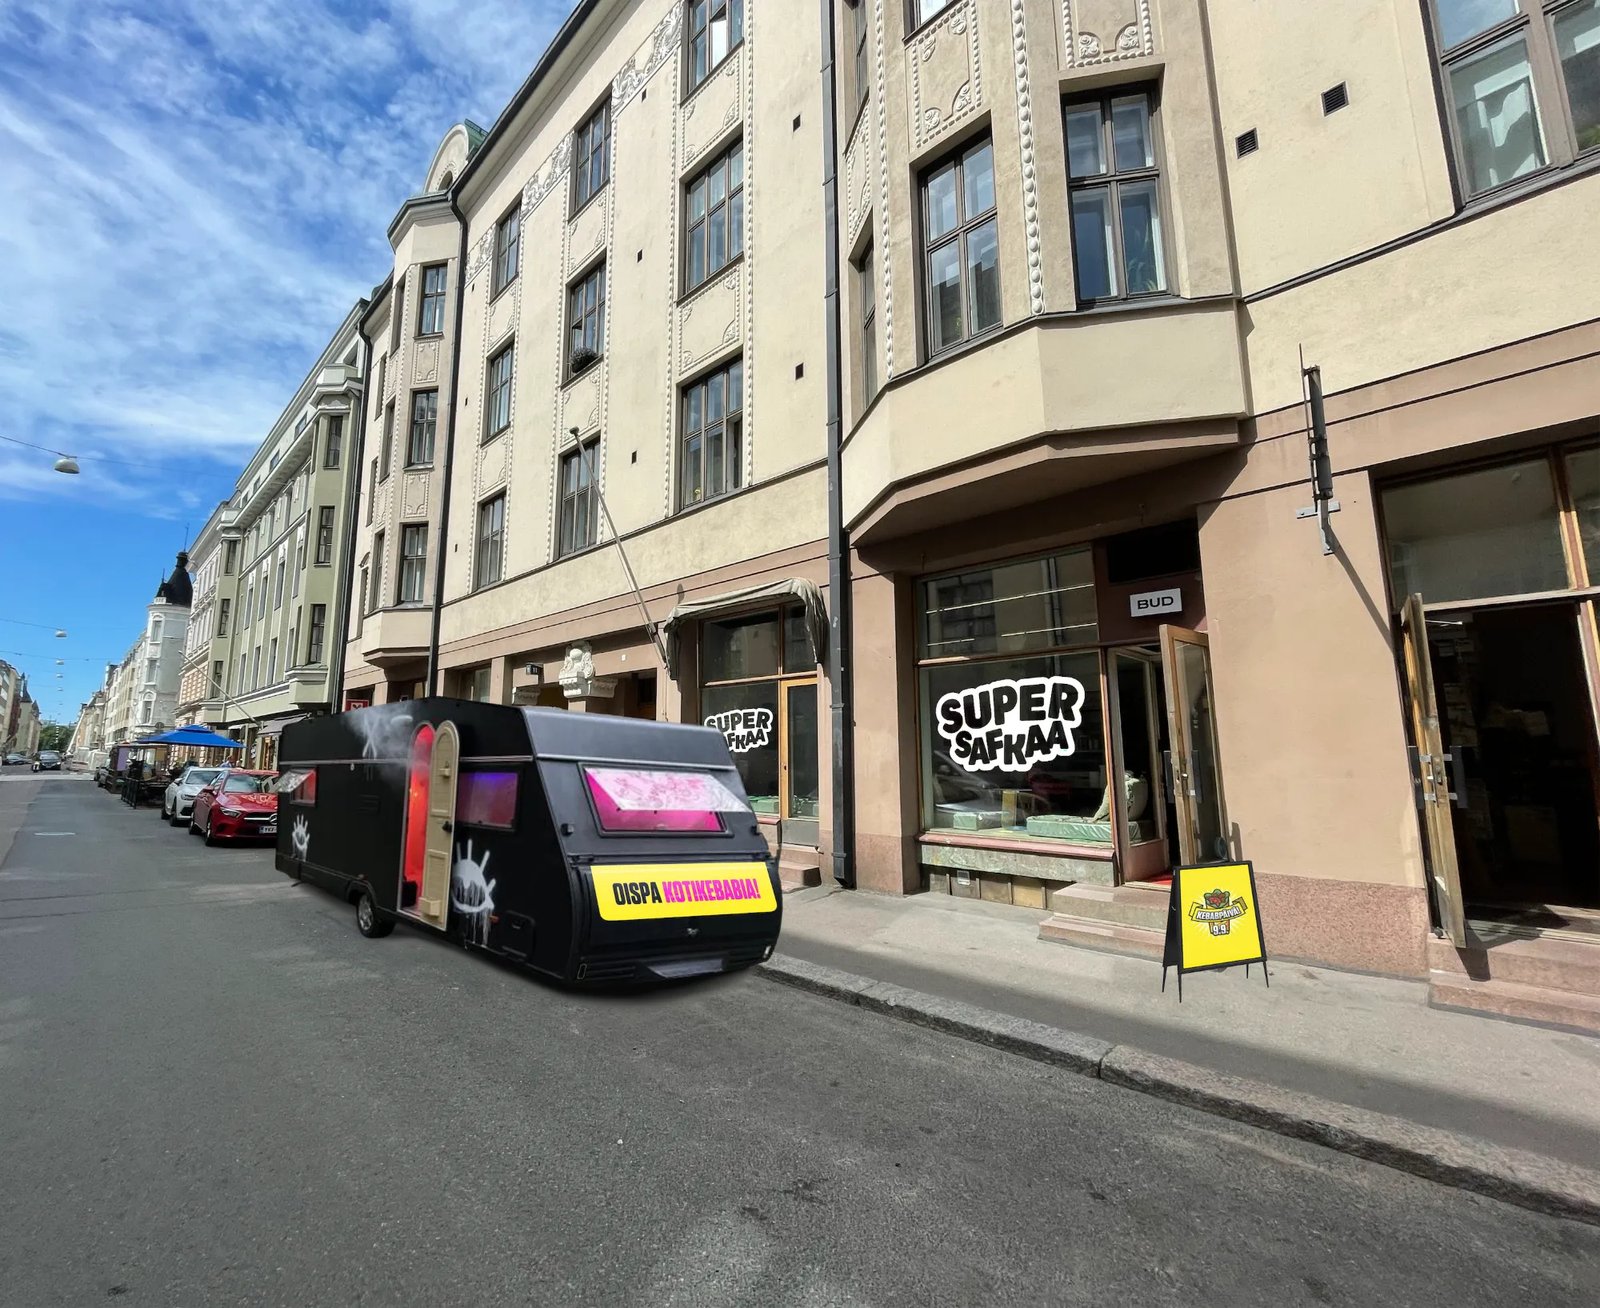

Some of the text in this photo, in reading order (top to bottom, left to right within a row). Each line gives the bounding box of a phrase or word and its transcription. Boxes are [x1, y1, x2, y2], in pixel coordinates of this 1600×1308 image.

[1136, 596, 1174, 610] BUD
[940, 682, 1079, 734] SUPER
[726, 728, 766, 750] FKAA
[953, 720, 1069, 766] SAFKAA
[612, 878, 762, 906] OISPA KOTIKEBABIA!
